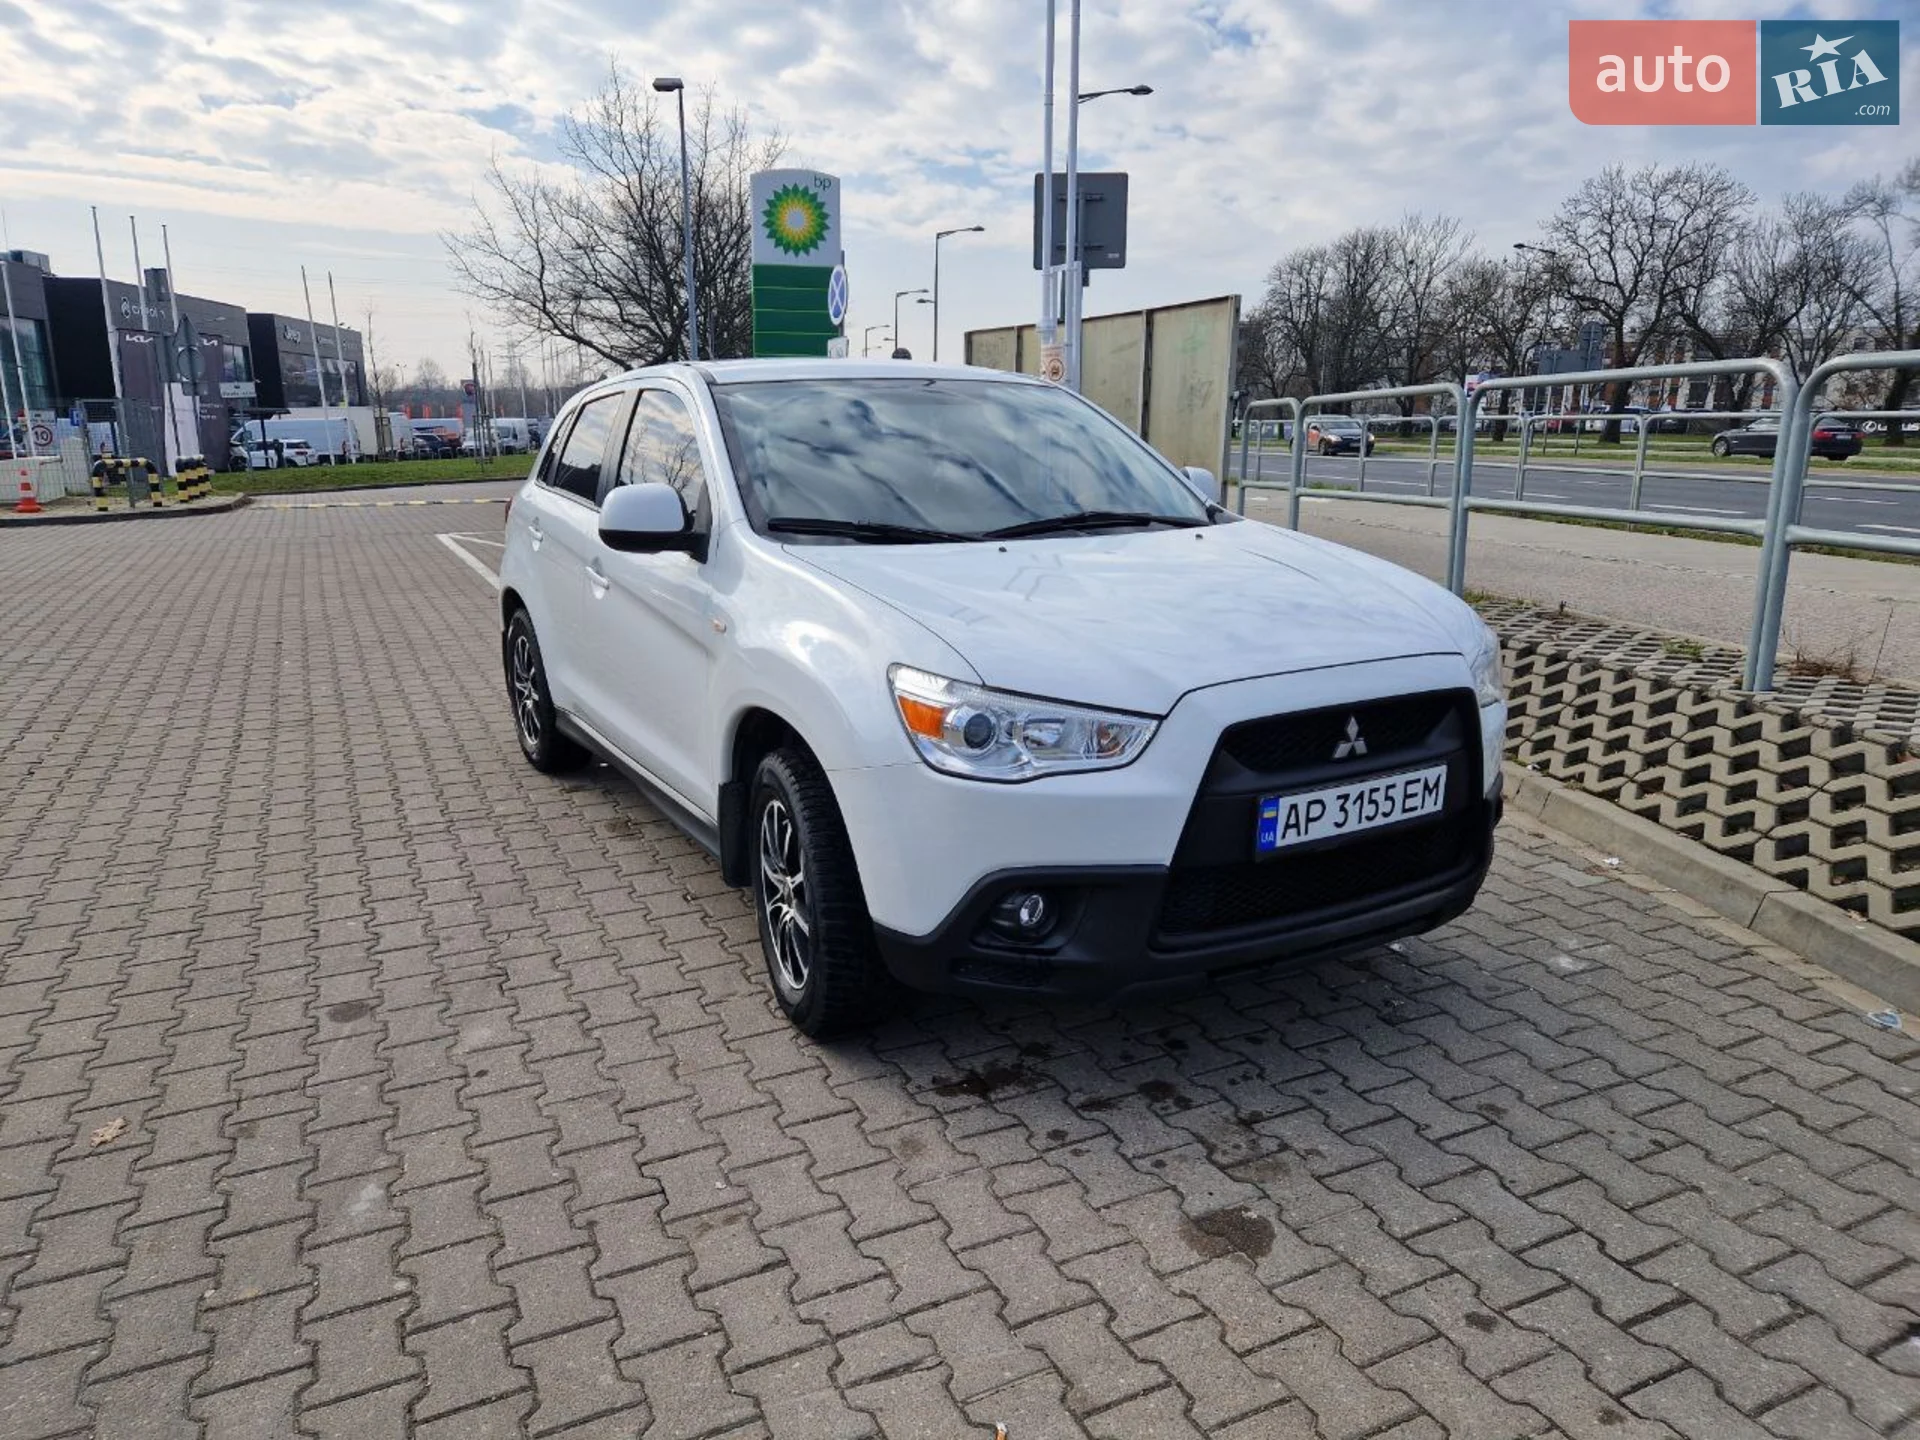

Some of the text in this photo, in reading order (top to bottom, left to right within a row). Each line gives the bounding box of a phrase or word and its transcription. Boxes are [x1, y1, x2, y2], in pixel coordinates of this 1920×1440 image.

[814, 175, 832, 191] bp
[34, 430, 49, 442] 10
[1281, 773, 1442, 840] AP 3155 EM
[1260, 831, 1275, 843] UA
